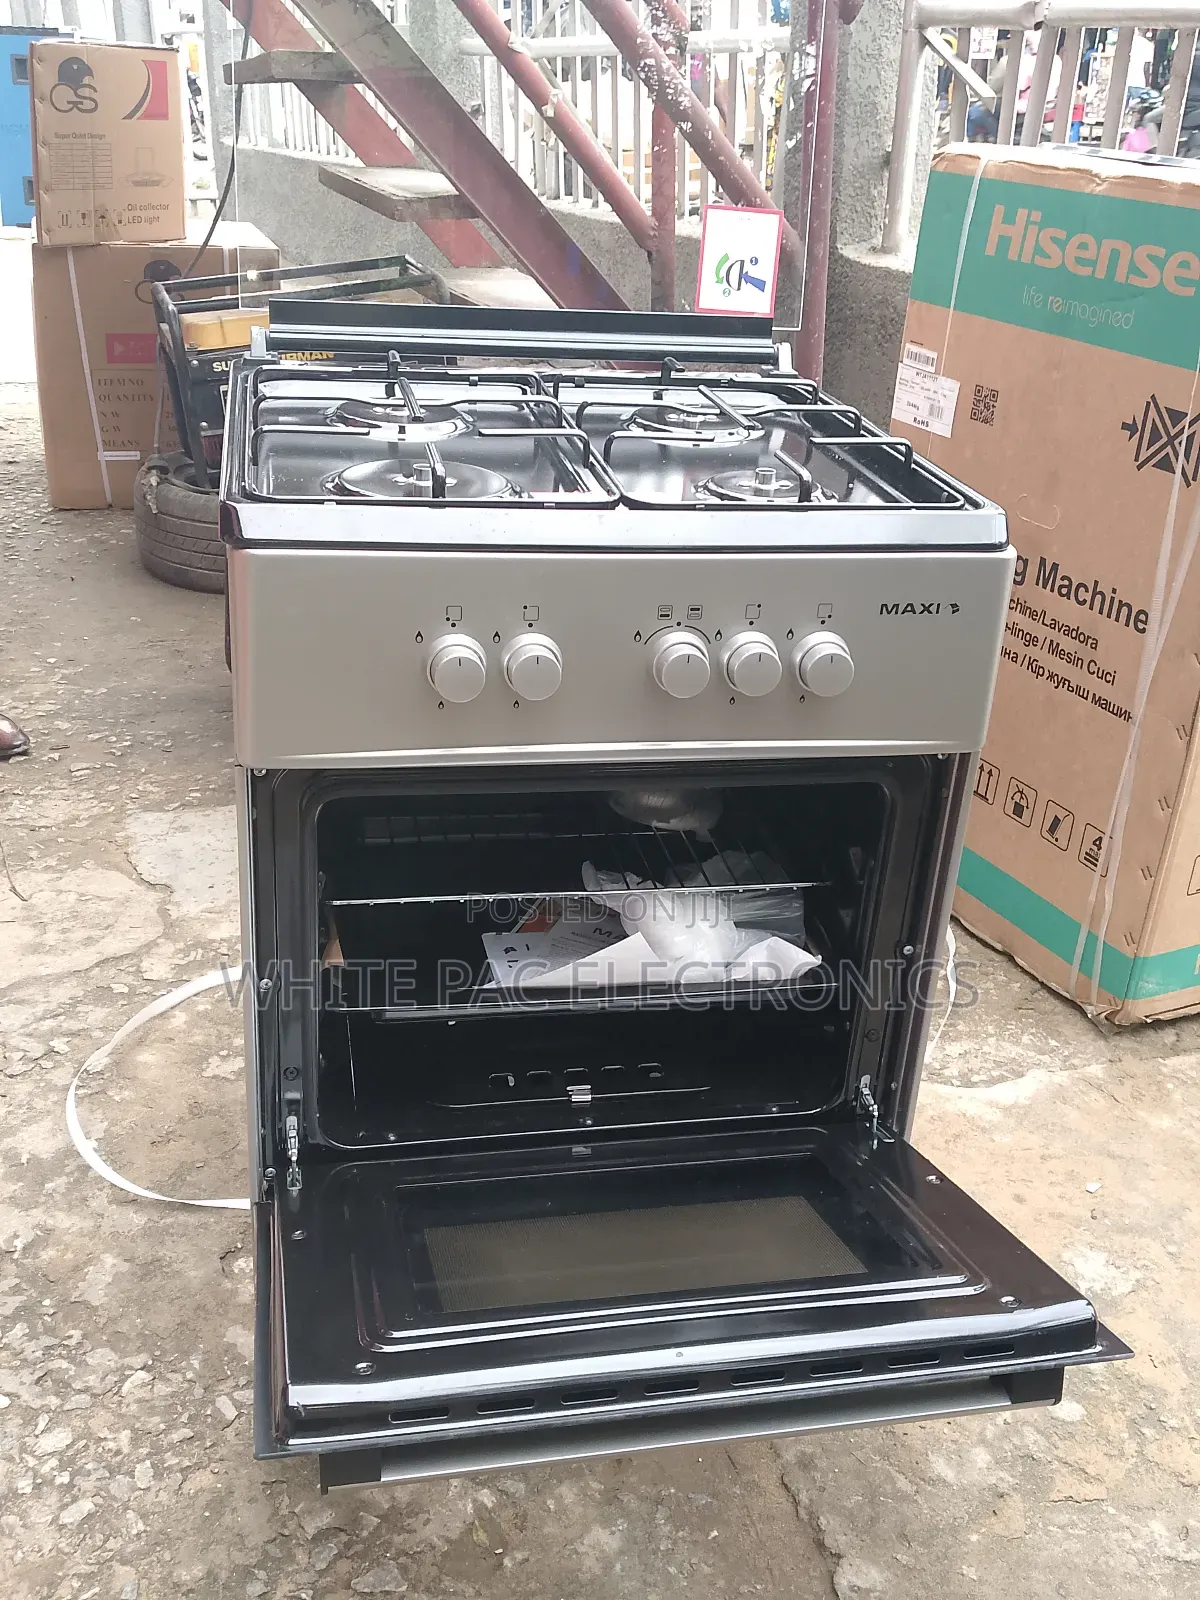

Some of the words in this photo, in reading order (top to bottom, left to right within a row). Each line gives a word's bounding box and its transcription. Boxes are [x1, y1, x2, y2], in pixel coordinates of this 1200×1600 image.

[127, 203, 138, 211] Oil
[139, 203, 169, 211] collector
[144, 216, 160, 225] light
[985, 204, 1200, 297] Hisense
[1022, 284, 1043, 308] life
[1047, 295, 1135, 329] reimagined
[98, 393, 154, 402] QUANTITY
[912, 417, 929, 428] RoHS
[1035, 556, 1149, 634] Machine
[879, 602, 941, 615] MAXI
[1005, 621, 1039, 647] -linge
[1048, 639, 1084, 670] Mesin
[1086, 659, 1117, 686] Cuci
[1092, 836, 1103, 852] 4
